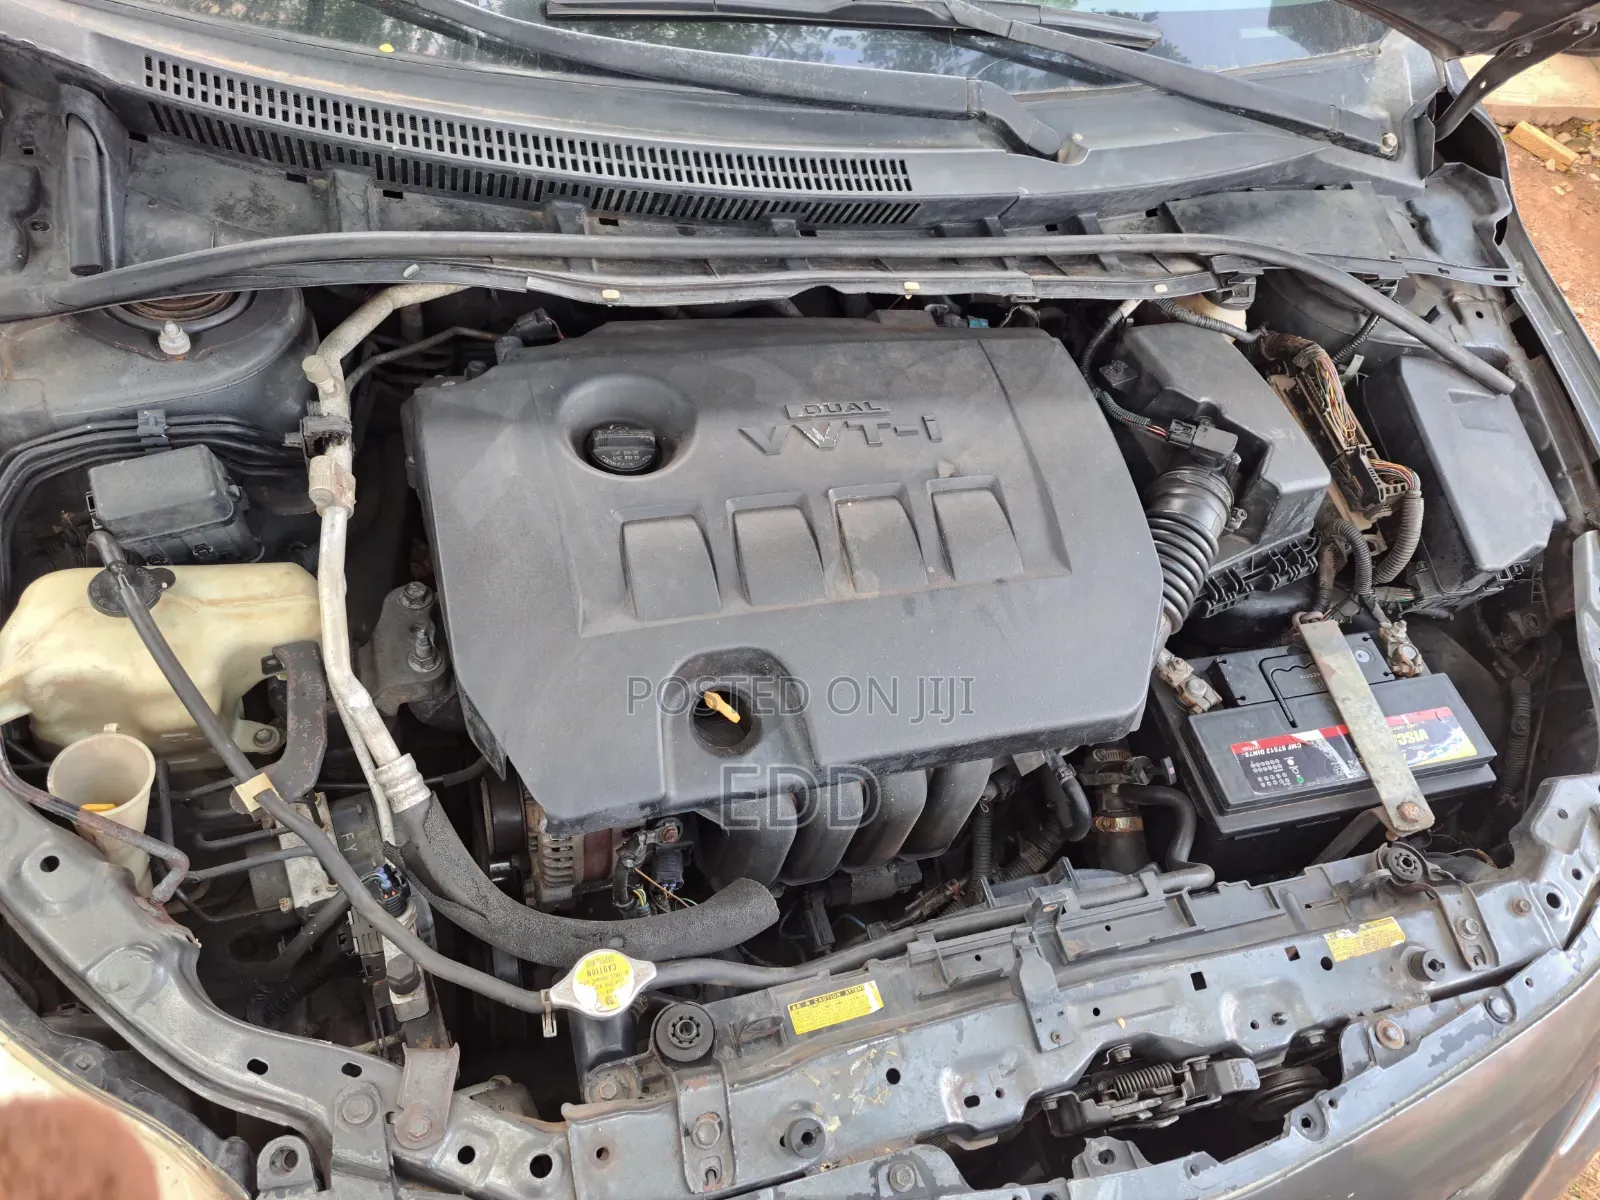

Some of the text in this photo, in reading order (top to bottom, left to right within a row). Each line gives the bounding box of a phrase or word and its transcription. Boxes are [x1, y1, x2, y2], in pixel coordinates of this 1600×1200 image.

[804, 401, 882, 415] DUAL
[1266, 745, 1287, 754] 57512
[1287, 742, 1302, 751] CMF
[587, 963, 617, 977] CAUTION
[814, 991, 841, 1004] CAUTION
